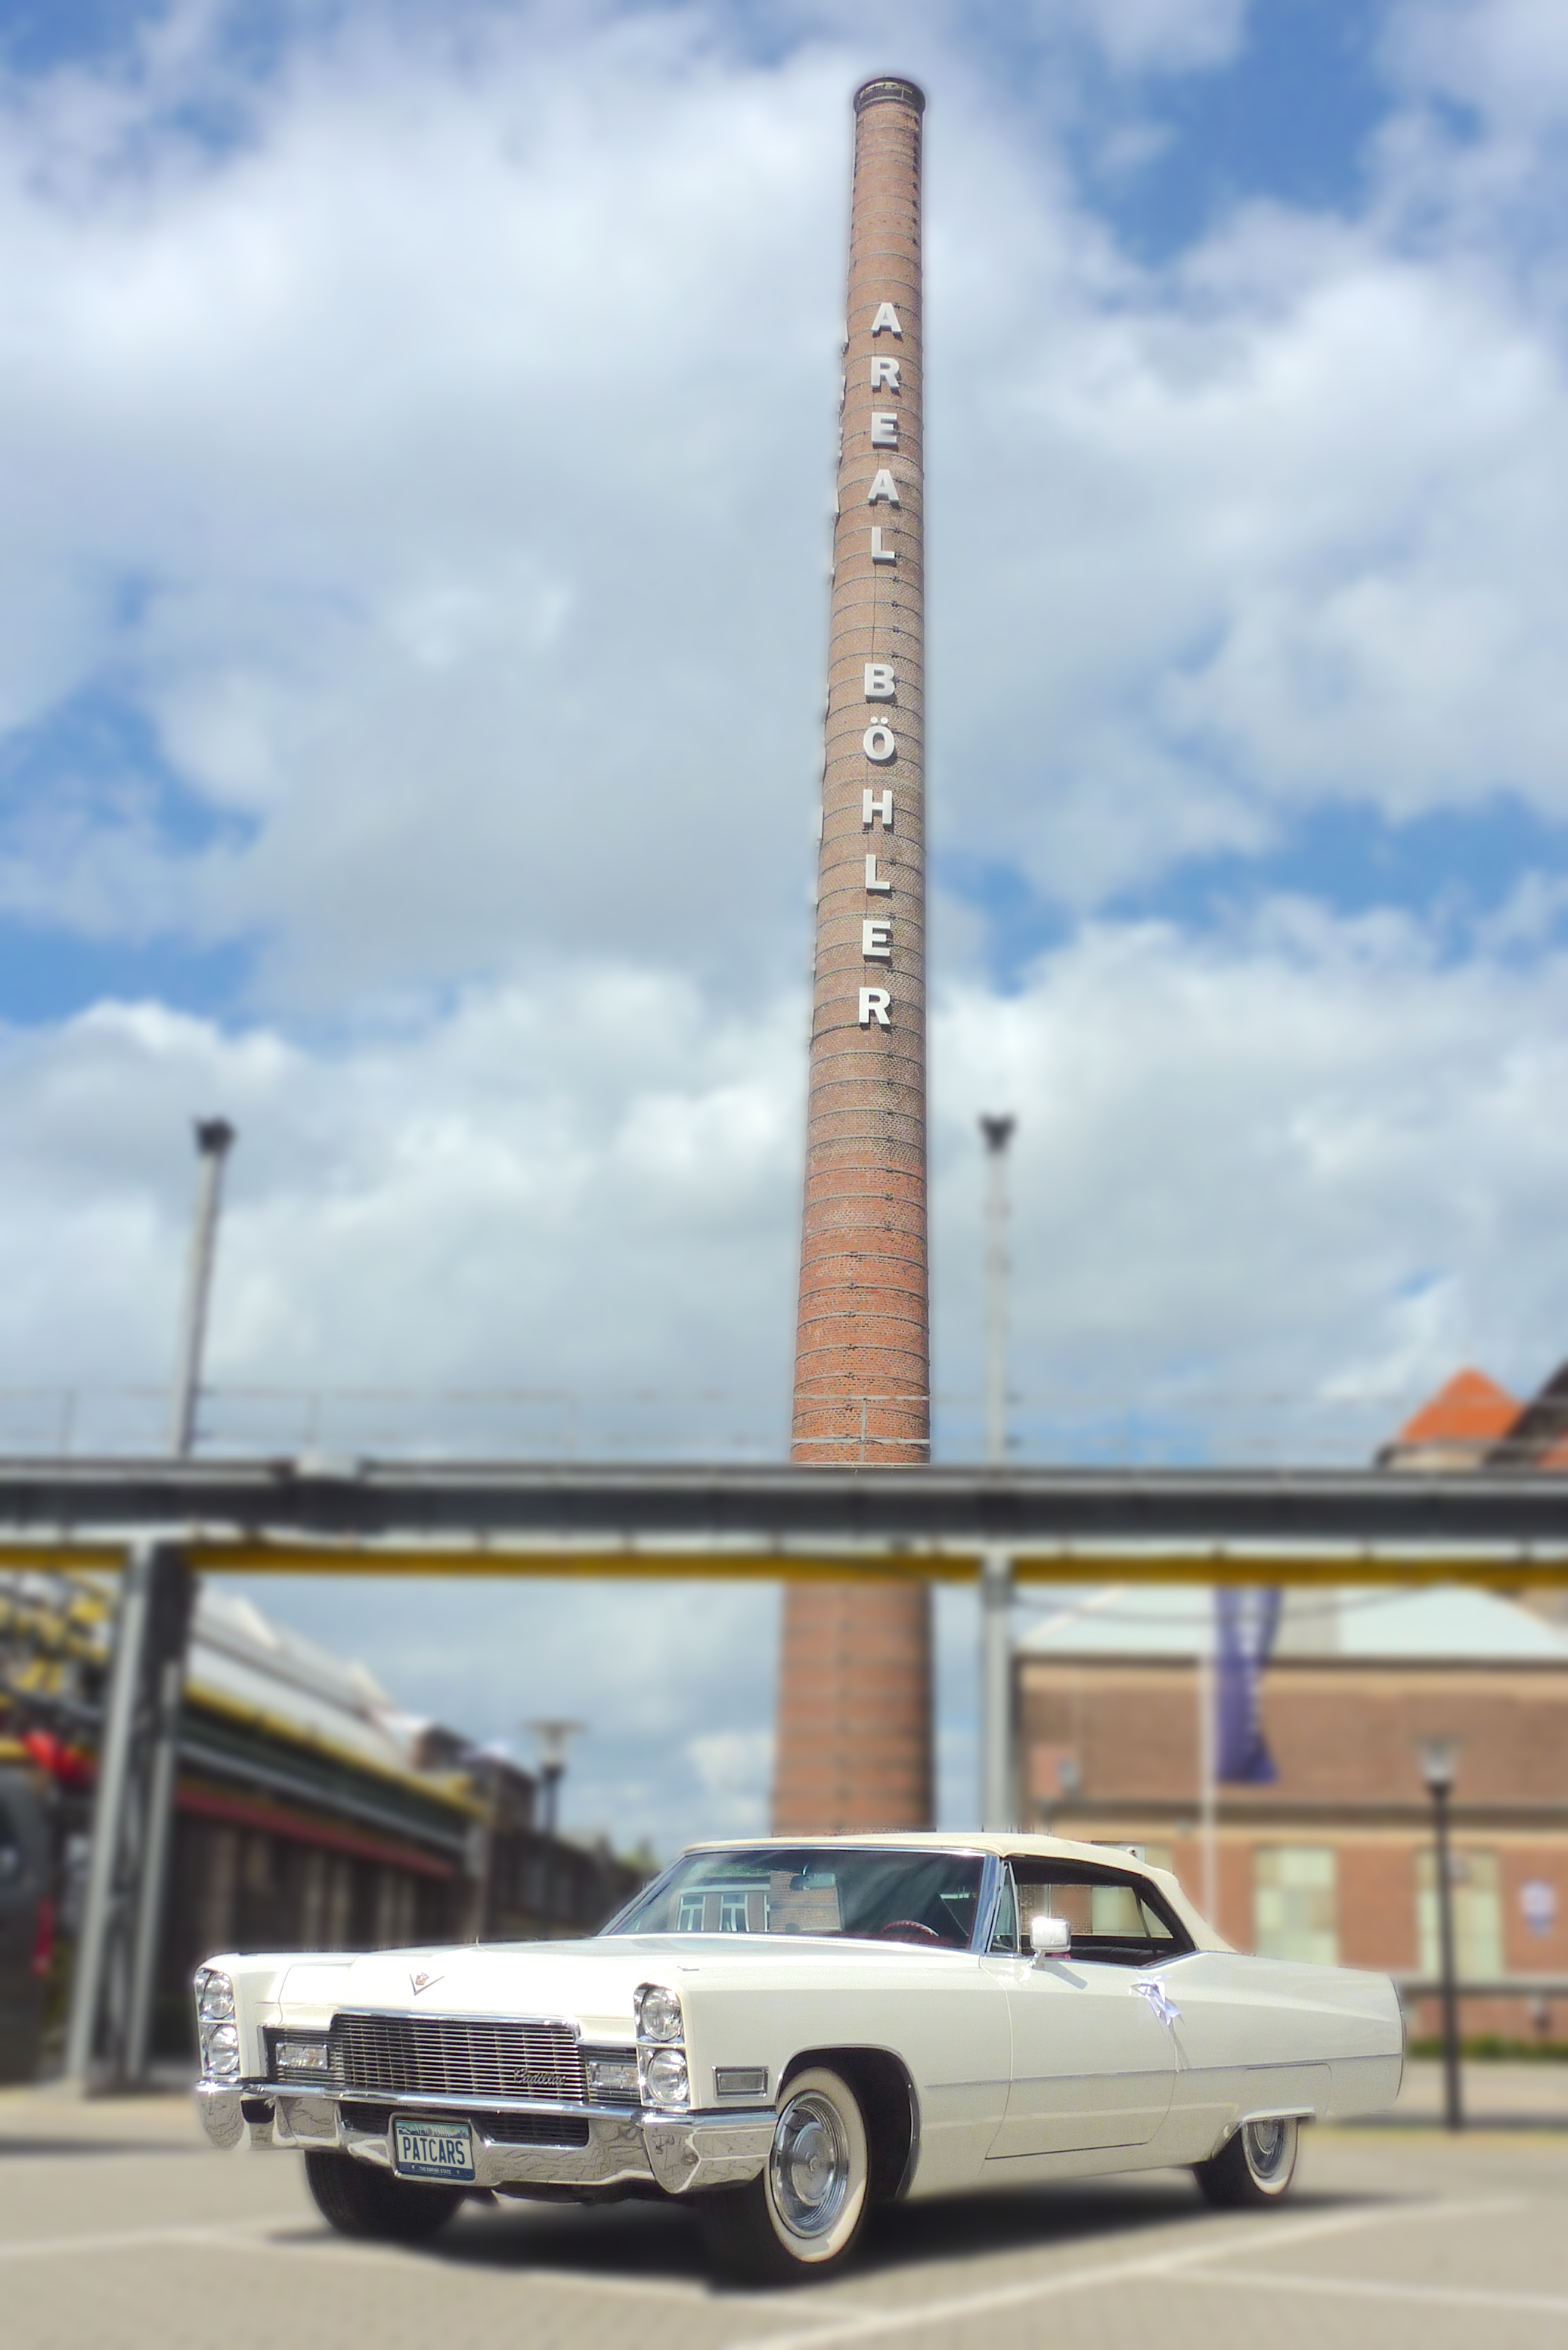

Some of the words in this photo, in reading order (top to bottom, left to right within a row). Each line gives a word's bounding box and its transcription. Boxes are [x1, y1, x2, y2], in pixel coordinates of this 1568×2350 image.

[868, 302, 902, 561] AREAL
[858, 663, 895, 1025] BÖHLER
[514, 2068, 566, 2085] Cadillac
[414, 2124, 431, 2135] NEW
[430, 2125, 451, 2137] YORK
[402, 2136, 465, 2165] PATCARS
